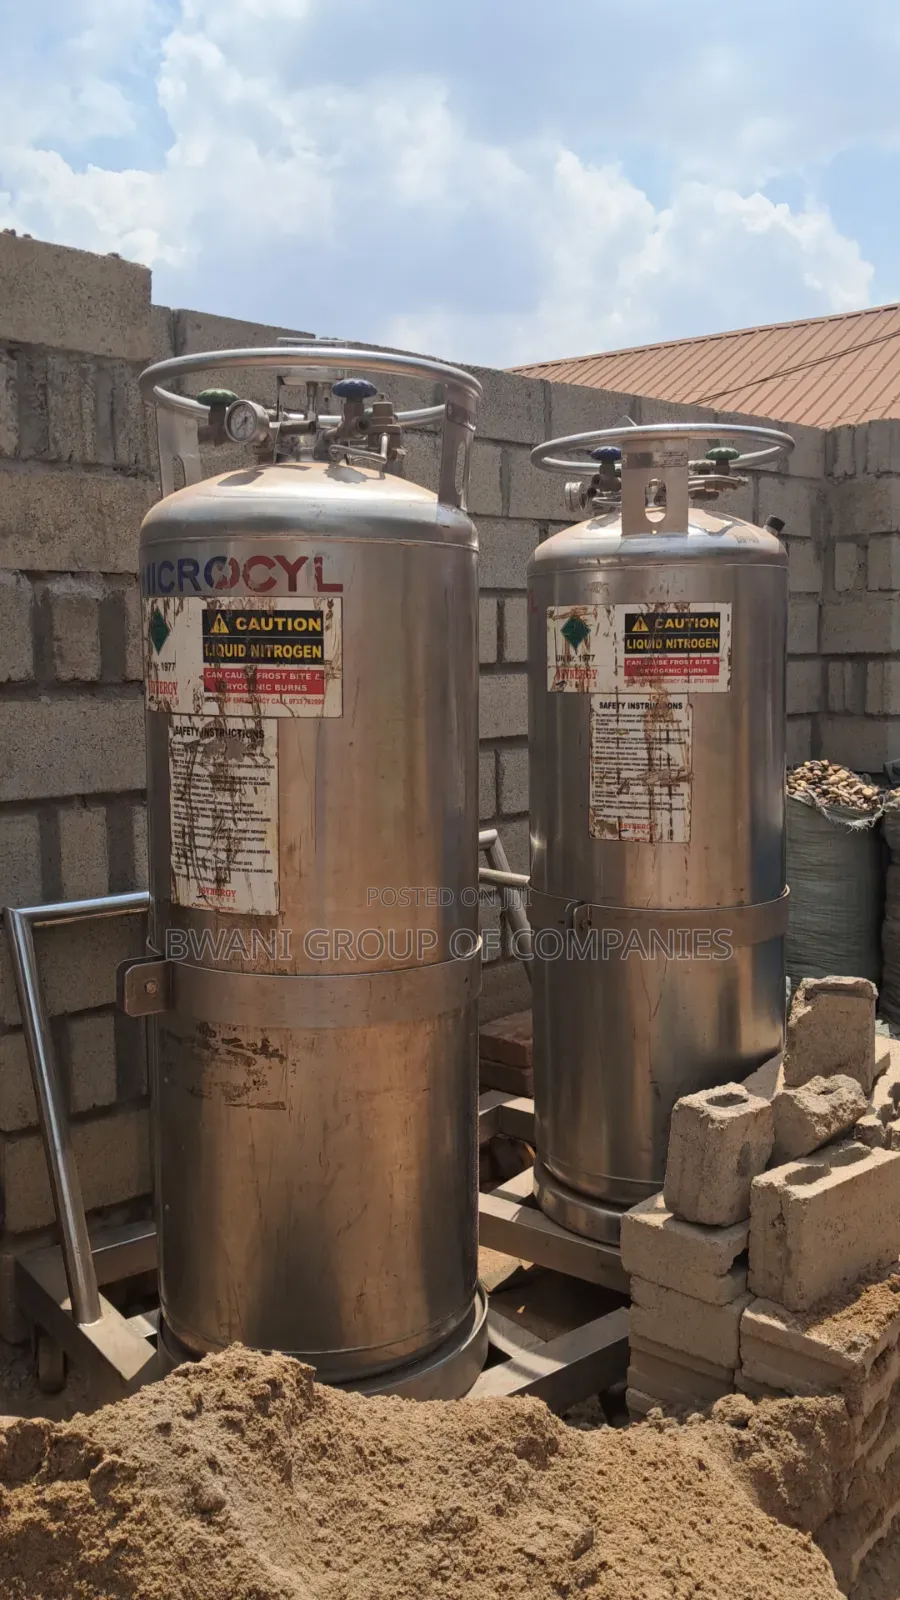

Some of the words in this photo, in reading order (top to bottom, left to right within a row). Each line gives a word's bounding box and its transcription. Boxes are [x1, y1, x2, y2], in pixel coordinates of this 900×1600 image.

[236, 616, 321, 631] CAUTION
[655, 618, 719, 629] CAUTION
[626, 638, 662, 649] LIQUID
[666, 638, 718, 649] NITROGEN
[250, 644, 322, 659] NITROGEN
[161, 662, 176, 672] 1977
[206, 671, 222, 679] CAN
[274, 684, 308, 692] BURNS
[599, 701, 625, 710] SAFETY
[175, 726, 200, 737] SAFETY
